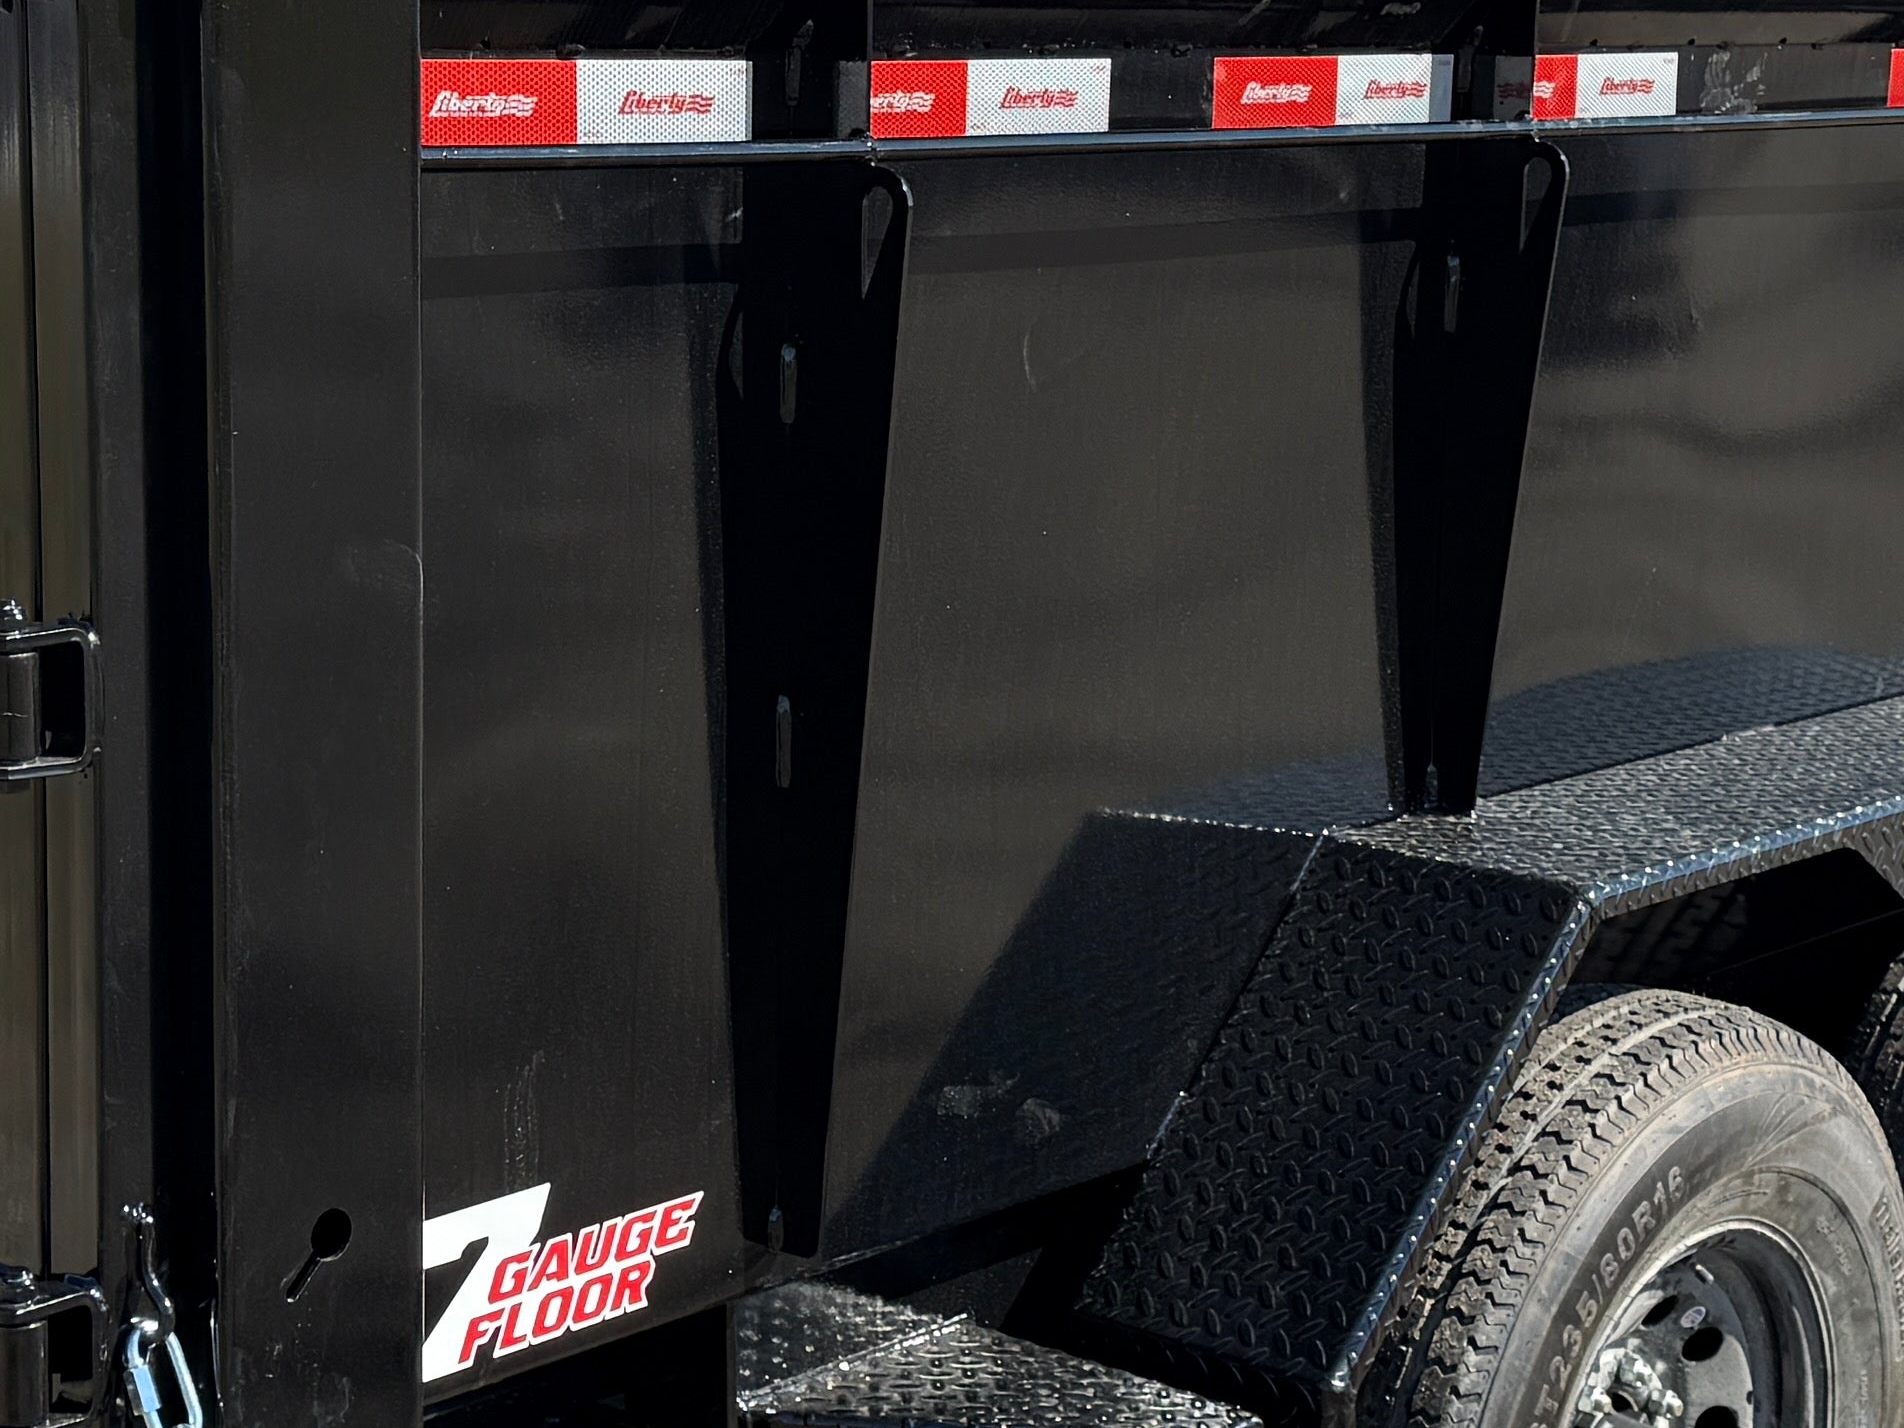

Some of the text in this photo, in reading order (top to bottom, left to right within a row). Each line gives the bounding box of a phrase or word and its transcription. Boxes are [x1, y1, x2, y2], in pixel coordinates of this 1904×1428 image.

[618, 90, 687, 115] Liberty
[422, 1182, 552, 1383] 7
[487, 1190, 705, 1306] GAUGE
[456, 1257, 657, 1366] FLOOR
